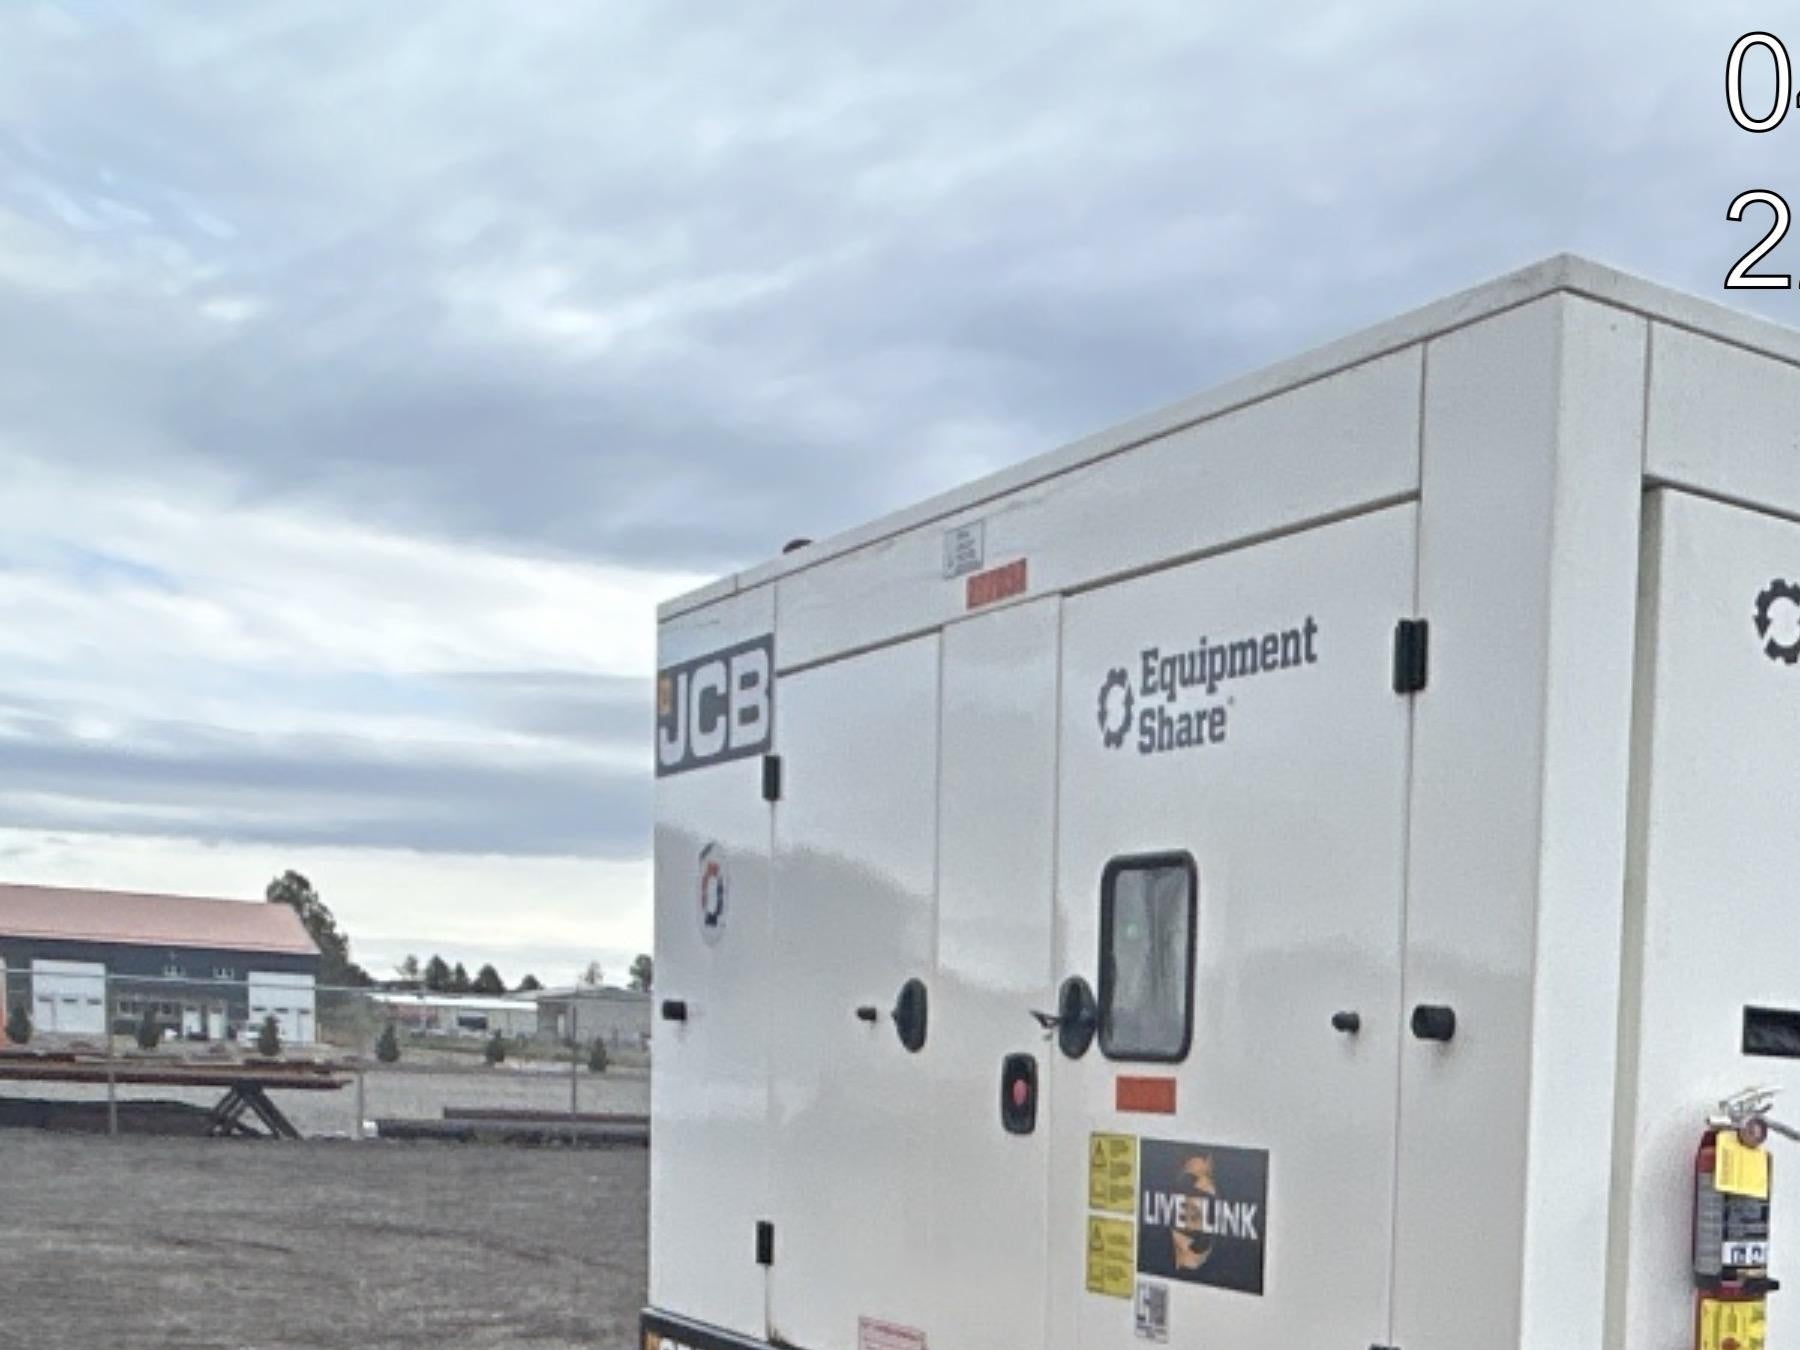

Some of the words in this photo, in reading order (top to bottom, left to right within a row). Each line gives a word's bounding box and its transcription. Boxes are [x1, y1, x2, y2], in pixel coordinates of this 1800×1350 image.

[1140, 614, 1318, 702] Equipment
[658, 647, 770, 767] JCB
[1138, 704, 1227, 755] Share
[1200, 1196, 1259, 1241] LINK
